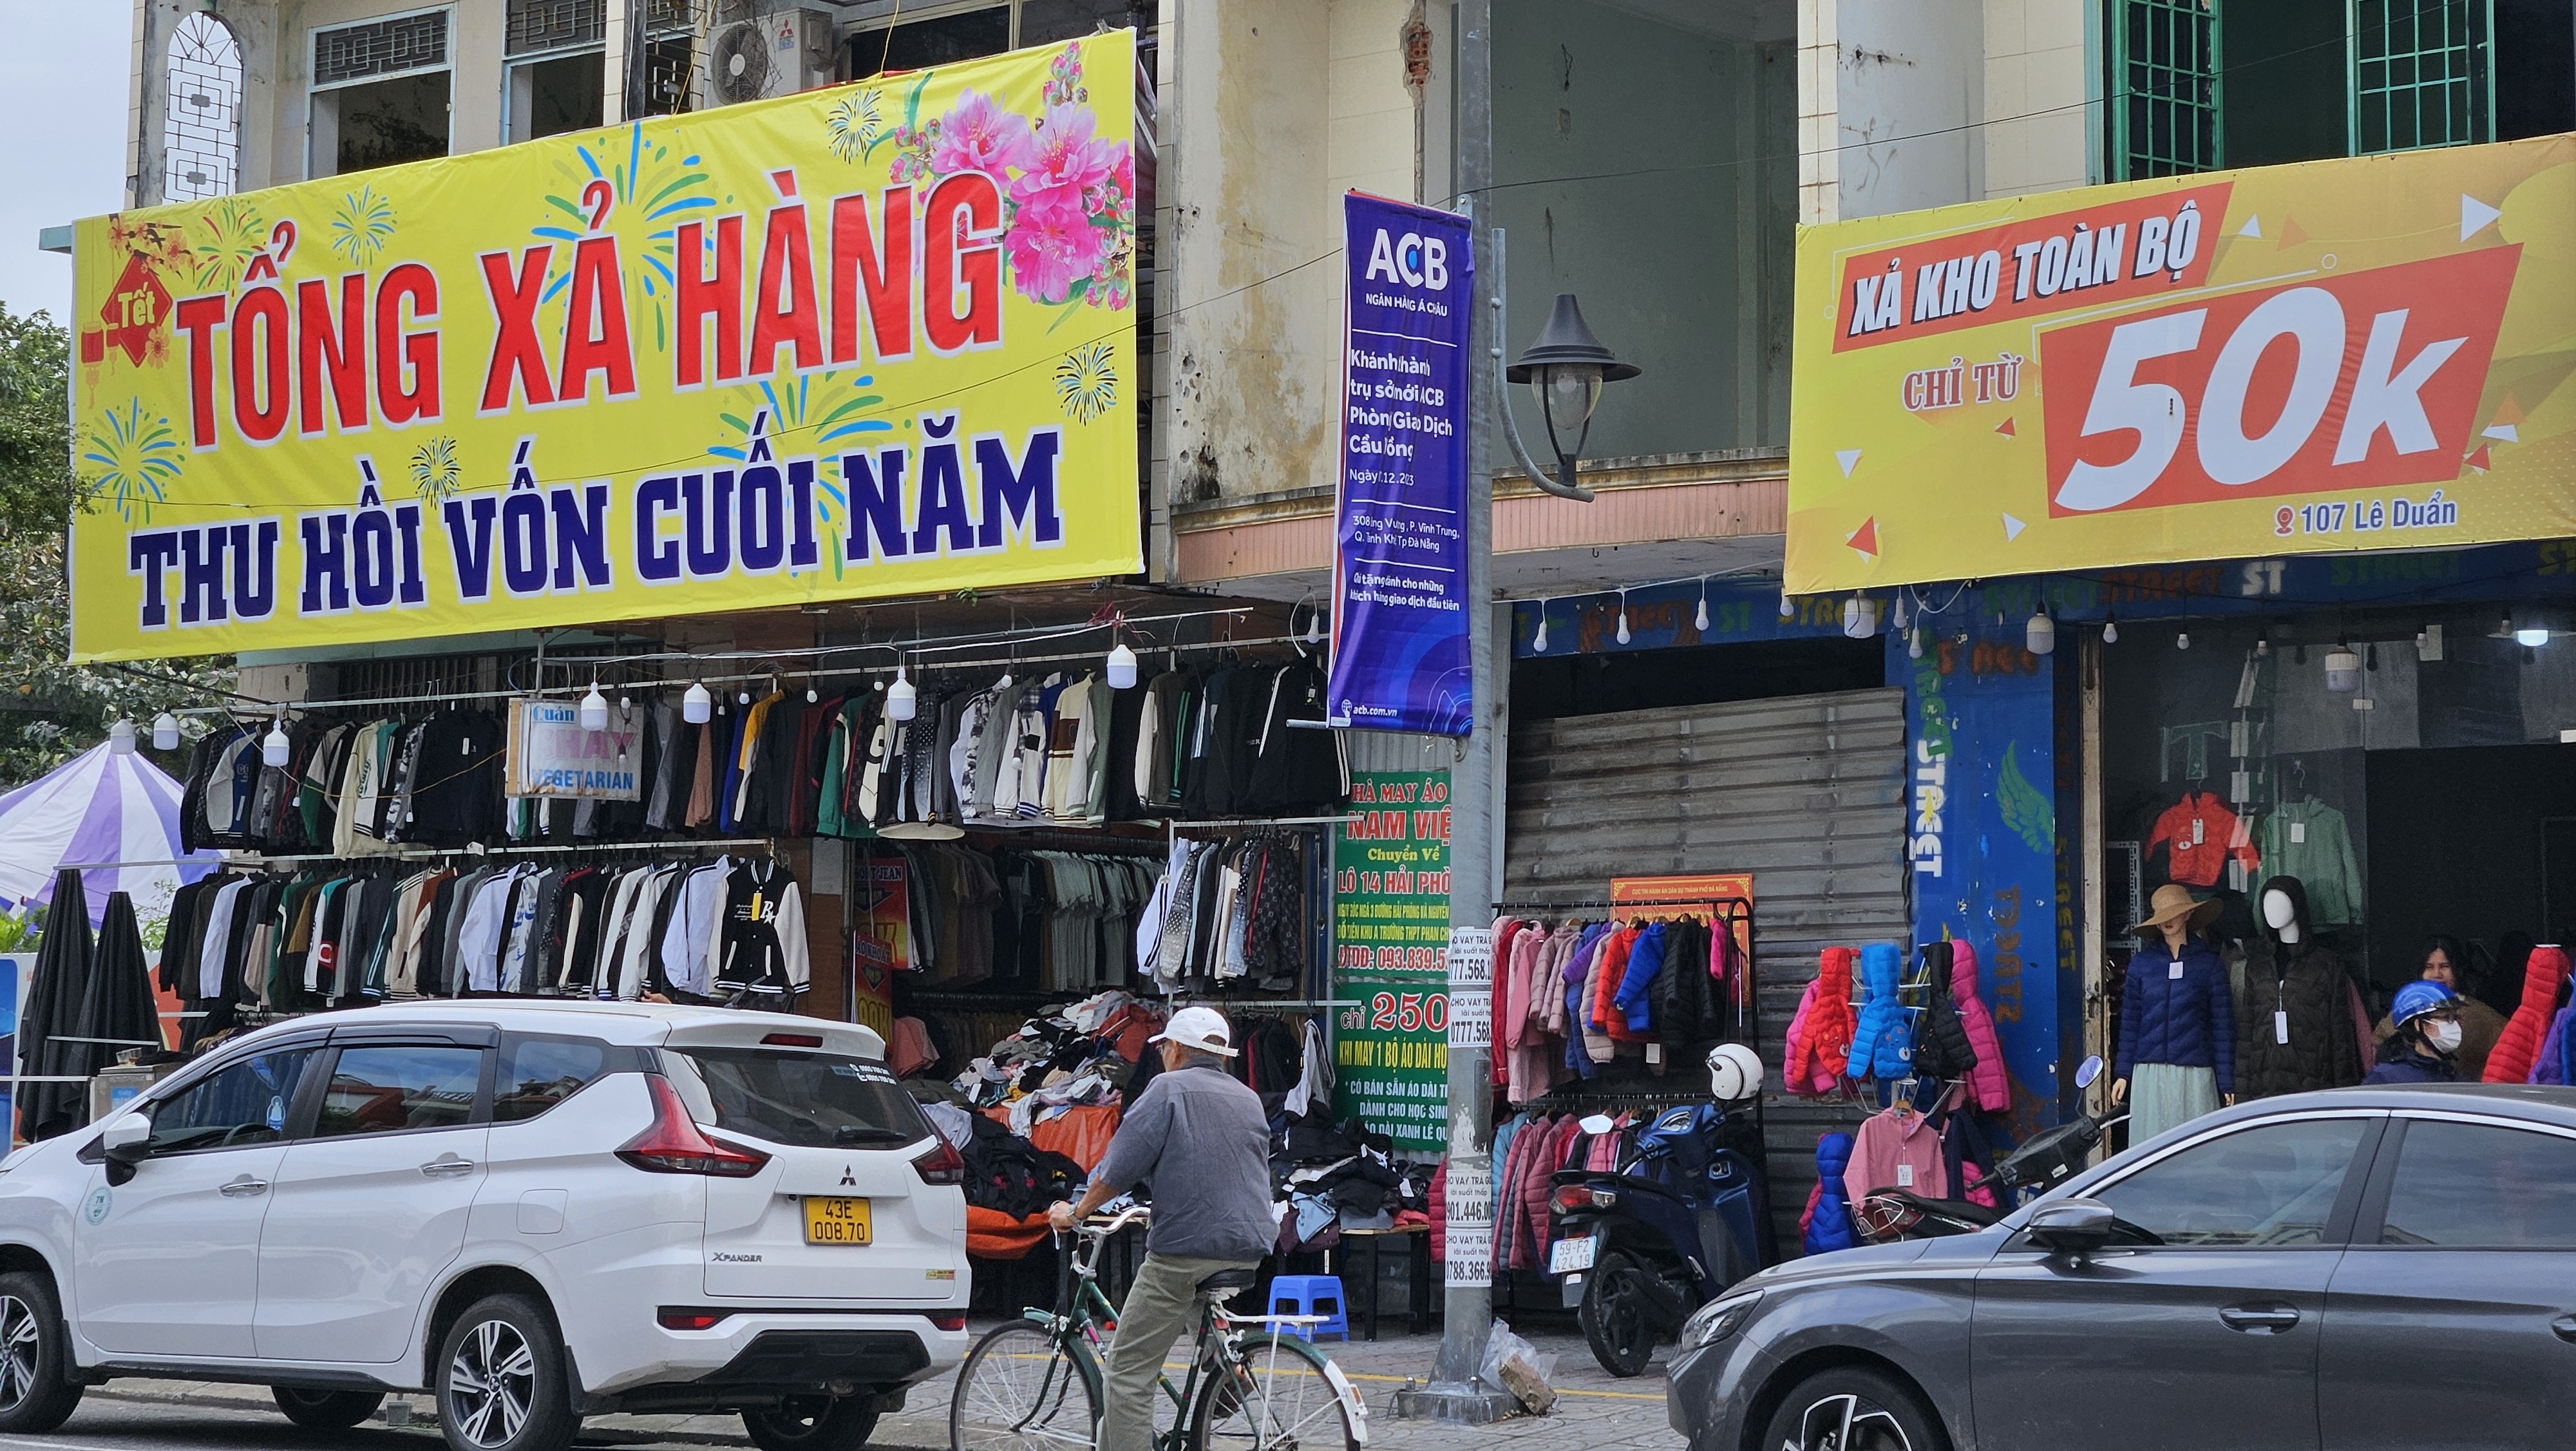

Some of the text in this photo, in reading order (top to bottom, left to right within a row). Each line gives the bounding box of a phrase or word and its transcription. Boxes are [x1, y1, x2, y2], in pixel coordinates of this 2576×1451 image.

[1366, 228, 1448, 290] ACB
[1847, 198, 2203, 338] XẢ KHO TOÀN BỘ
[118, 281, 155, 329] Tết
[175, 170, 1001, 449] TỔNG XẢ HÀNG
[1366, 292, 1392, 307] NGÂN
[1418, 299, 1426, 312] Á
[1352, 349, 1397, 371] Khánh
[1350, 379, 1371, 401] trụ
[1375, 380, 1394, 398] sở
[1902, 352, 2026, 412] CHỈ TỪ
[1424, 415, 1452, 438] Dịch
[1350, 434, 1414, 462] Cầu ồng
[1350, 469, 1378, 484] Ngày
[130, 412, 1059, 627] THU HỒI VỐN CUỐI NĂM
[2302, 489, 2456, 534] 107 Lê Duẩn
[1353, 516, 1370, 526] 308
[1410, 521, 1417, 532] P.
[1435, 524, 1460, 540] Trung,
[1355, 531, 1439, 553] Q. Tp Đà Nẵng
[1402, 577, 1417, 589] cho
[1419, 580, 1444, 595] những
[2242, 560, 2287, 595] ST
[1389, 593, 1406, 607] giao
[1408, 595, 1426, 609] dịch
[1443, 599, 1460, 611] tiên
[1353, 705, 1397, 717] acb.com.vn
[532, 768, 633, 790] VEGETARIAN
[1350, 777, 1447, 804] HÀ MAY ÁO
[1347, 804, 1452, 846] NAM VIỆ
[1368, 844, 1440, 863] Chuyển Về
[878, 866, 903, 881] JEAN
[1338, 864, 1451, 895] LÔ 14 HẢI PHÒ
[1370, 904, 1374, 918] 3
[1374, 925, 1378, 940] A
[1405, 925, 1421, 940] THPT
[1421, 926, 1439, 941] PHAN
[1439, 926, 1449, 941] CH
[1460, 936, 1474, 944] VAY
[1476, 933, 1488, 945] TRẢ
[1377, 945, 1448, 971] 093.839.5
[1449, 958, 1492, 980] 777.568.1
[1340, 992, 1448, 1032] chỉ 250
[1451, 998, 1465, 1007] CHO
[1467, 998, 1481, 1007] VAY
[1451, 1021, 1492, 1043] 0777.568
[1339, 1036, 1447, 1074] KHI MAY 1 BỘ ÁO DÀI HỌ
[1350, 1077, 1447, 1098] CÓ BÁN SẴN ÁO DÀI T
[1359, 1101, 1385, 1117] DÀNH
[1387, 1103, 1405, 1117] CHO
[1408, 1103, 1426, 1121] HỌC
[1396, 1123, 1420, 1139] XANH
[1422, 1123, 1433, 1139] LÊ
[1435, 1124, 1447, 1141] QU
[1455, 1176, 1469, 1185] VAY
[1472, 1173, 1484, 1185] TRẢ
[824, 1200, 853, 1219] 43E
[815, 1222, 866, 1242] 008.70
[1459, 1235, 1473, 1244] VAY
[1476, 1232, 1486, 1244] TRẢ
[712, 1251, 762, 1263] XPANDER
[1559, 1240, 1589, 1256] 59-F2
[1555, 1254, 1590, 1271] 424.19
